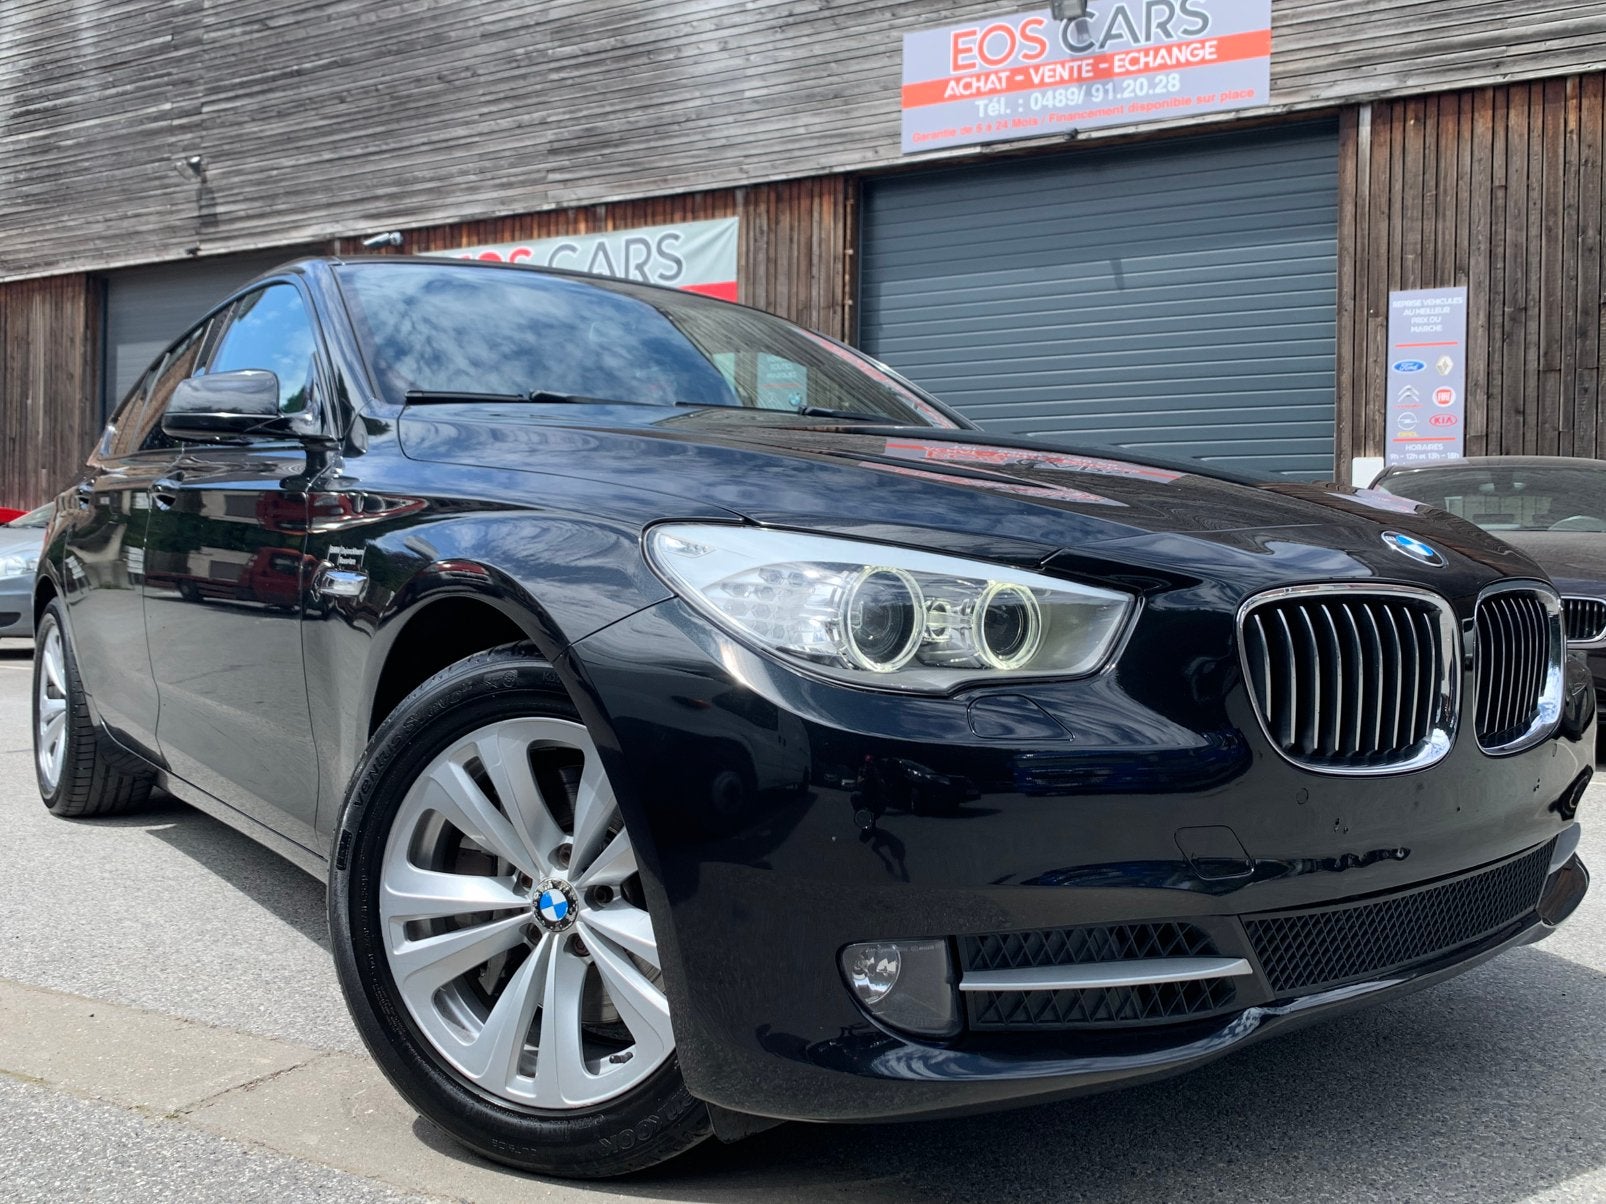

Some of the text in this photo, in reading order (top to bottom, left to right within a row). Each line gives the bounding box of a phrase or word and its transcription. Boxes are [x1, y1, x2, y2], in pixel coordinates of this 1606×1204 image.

[951, 0, 1211, 73] EOS CARS
[944, 71, 1010, 98] ACHAT
[1029, 60, 1094, 84] VENTE
[1113, 40, 1218, 73] ECHANGE
[975, 98, 1011, 117] Tél.
[1030, 86, 1086, 111] 0489/
[1091, 73, 1180, 102] 91.20.28
[912, 127, 957, 144] Garantie
[960, 124, 973, 136] de
[995, 118, 1009, 131] 24
[1012, 115, 1039, 128] Mois
[1048, 105, 1124, 123] Financement
[1128, 96, 1192, 114] disponible
[1196, 94, 1216, 105] sur
[1220, 88, 1255, 104] place
[1392, 296, 1464, 308] REPRISE VEHICULES
[1403, 306, 1450, 316] AU MEILLEUR
[1433, 416, 1453, 424] KIA
[1405, 443, 1444, 451] HORAIRES
